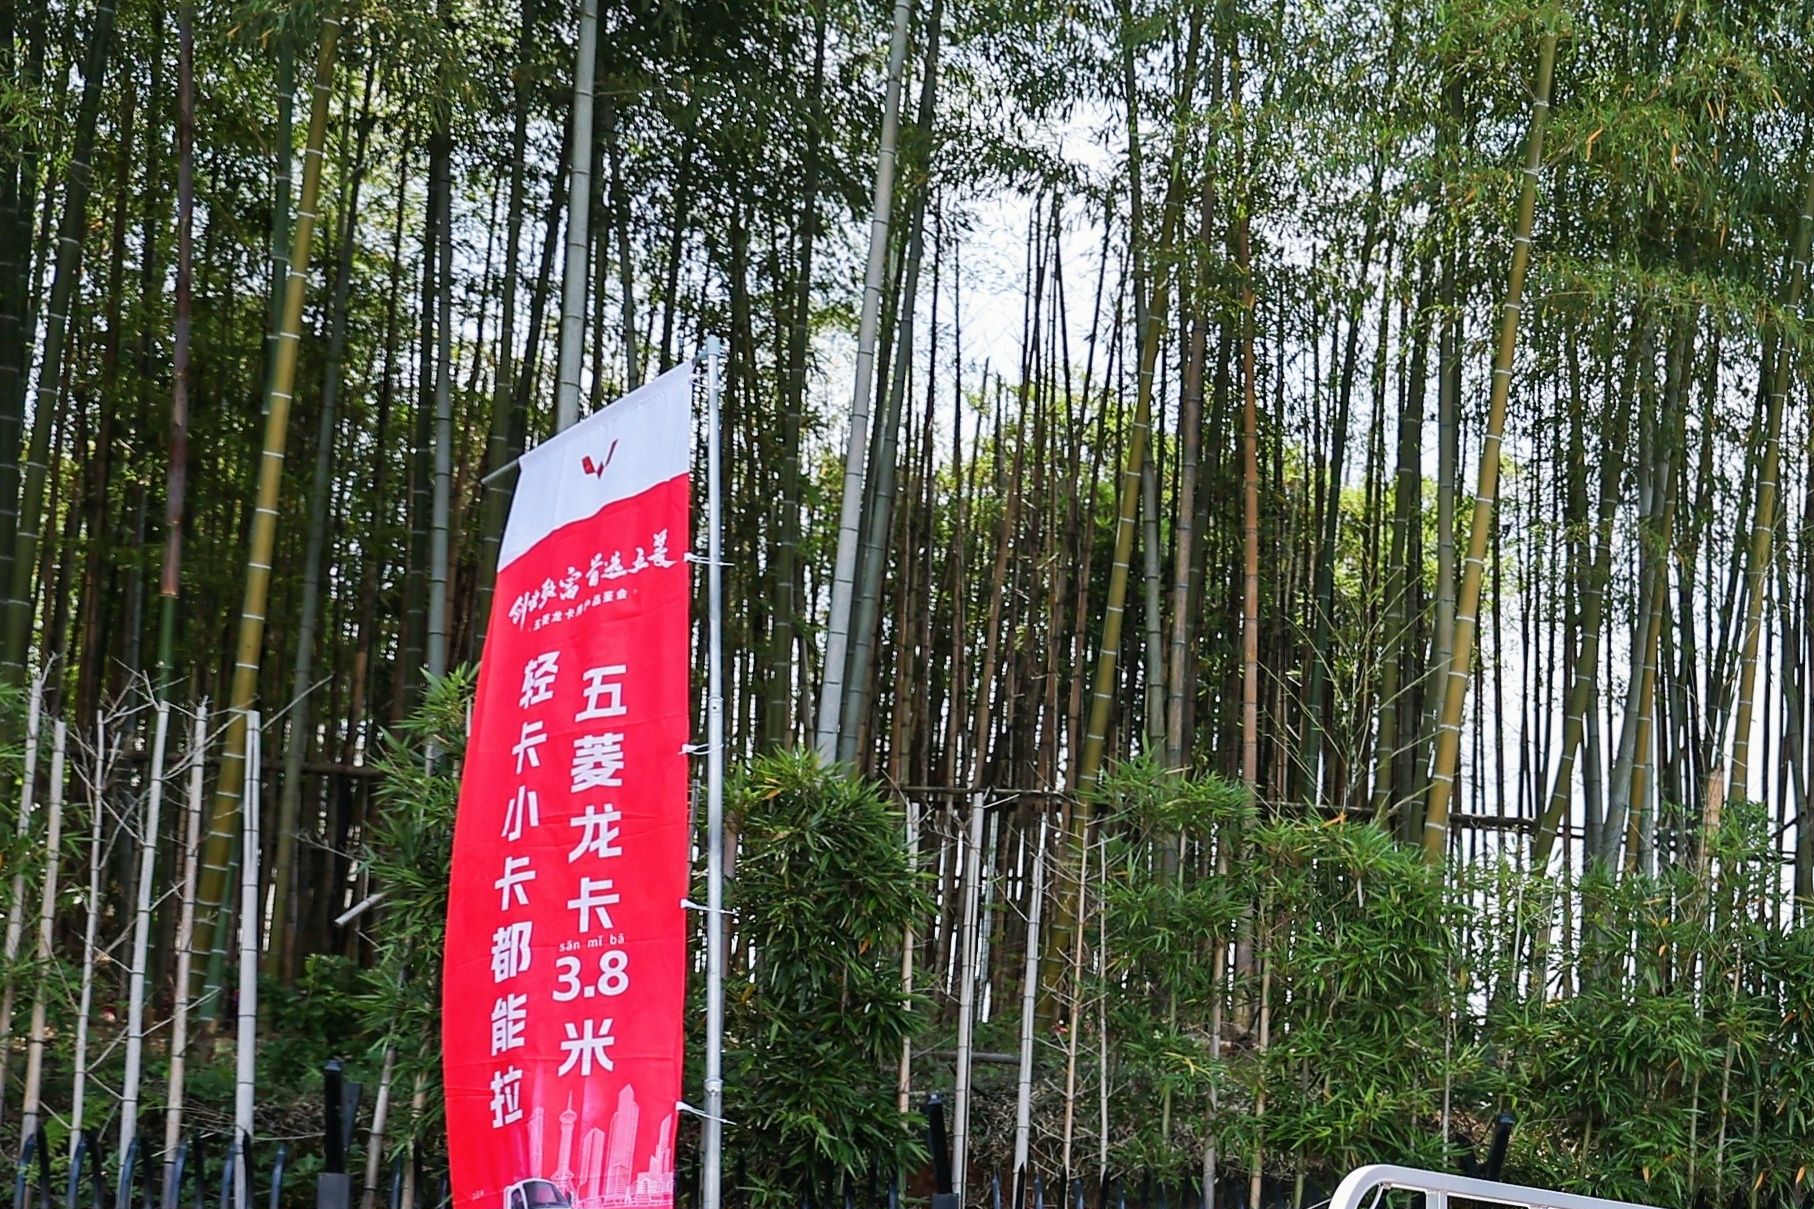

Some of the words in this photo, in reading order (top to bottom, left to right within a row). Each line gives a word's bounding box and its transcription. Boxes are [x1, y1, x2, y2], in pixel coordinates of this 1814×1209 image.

[490, 650, 561, 1129] 轻卡小卡都能拉
